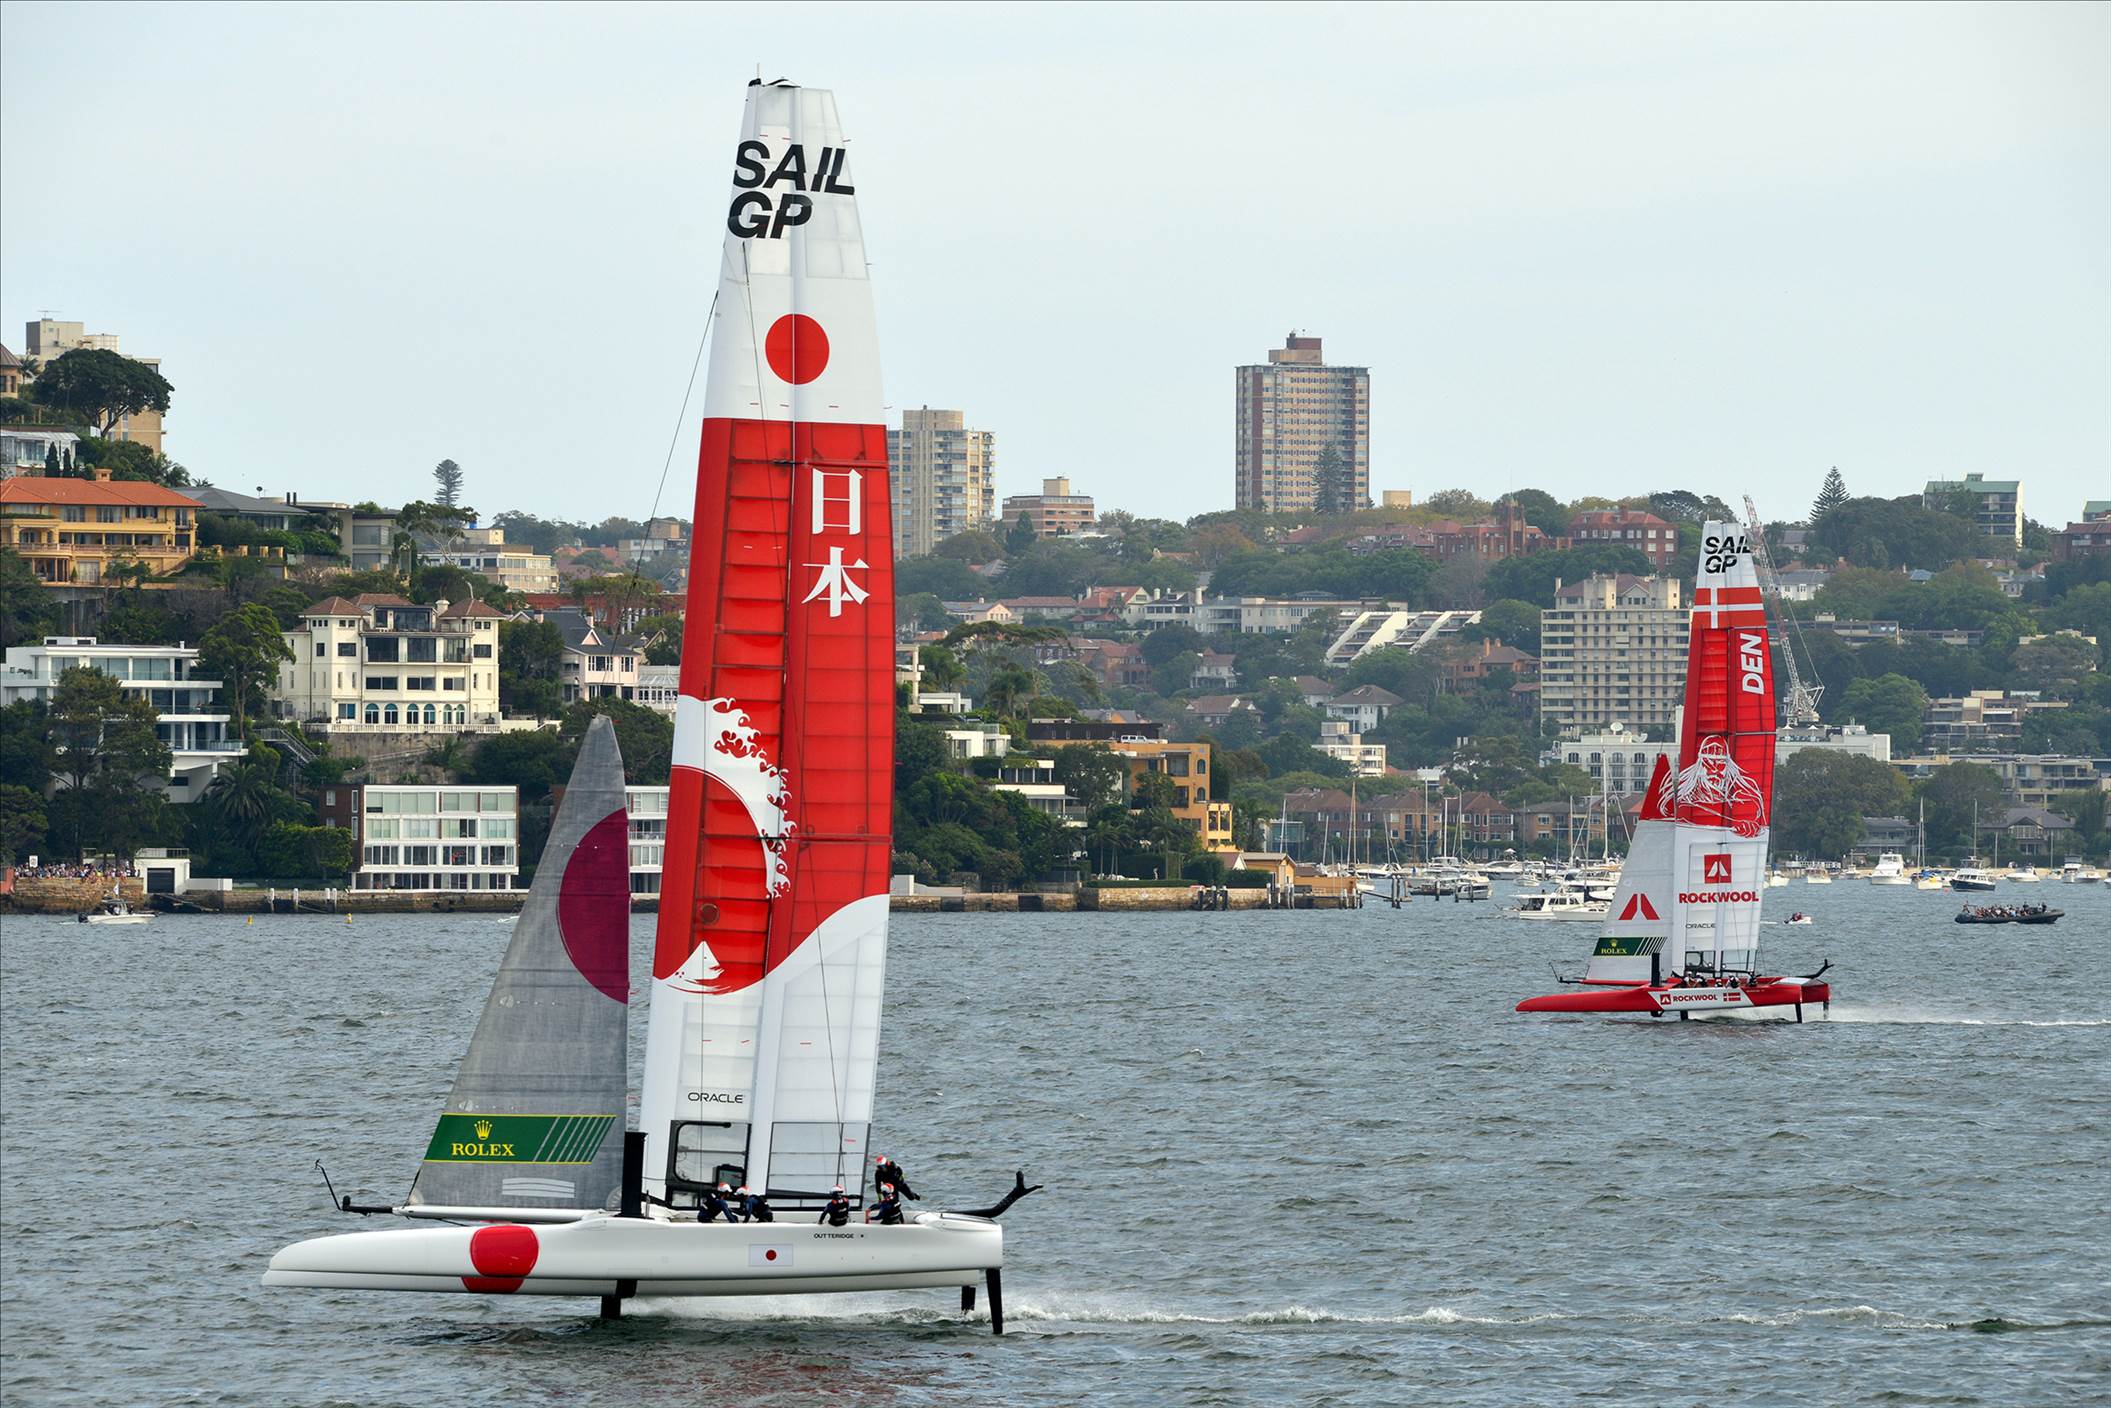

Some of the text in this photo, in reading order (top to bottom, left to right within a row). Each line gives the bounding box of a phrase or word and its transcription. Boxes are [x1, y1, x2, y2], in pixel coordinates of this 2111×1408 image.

[734, 140, 854, 195] SAIL
[728, 191, 812, 239] GP
[803, 468, 868, 617] 日本
[1704, 536, 1752, 554] SAIL
[1705, 555, 1737, 573] GP
[1741, 633, 1764, 695] DEN
[1679, 892, 1758, 904] ROCKWOOL
[1673, 994, 1717, 1002] ROCKWOOL
[688, 1092, 743, 1104] ORACLE
[451, 1143, 514, 1156] ROLEX
